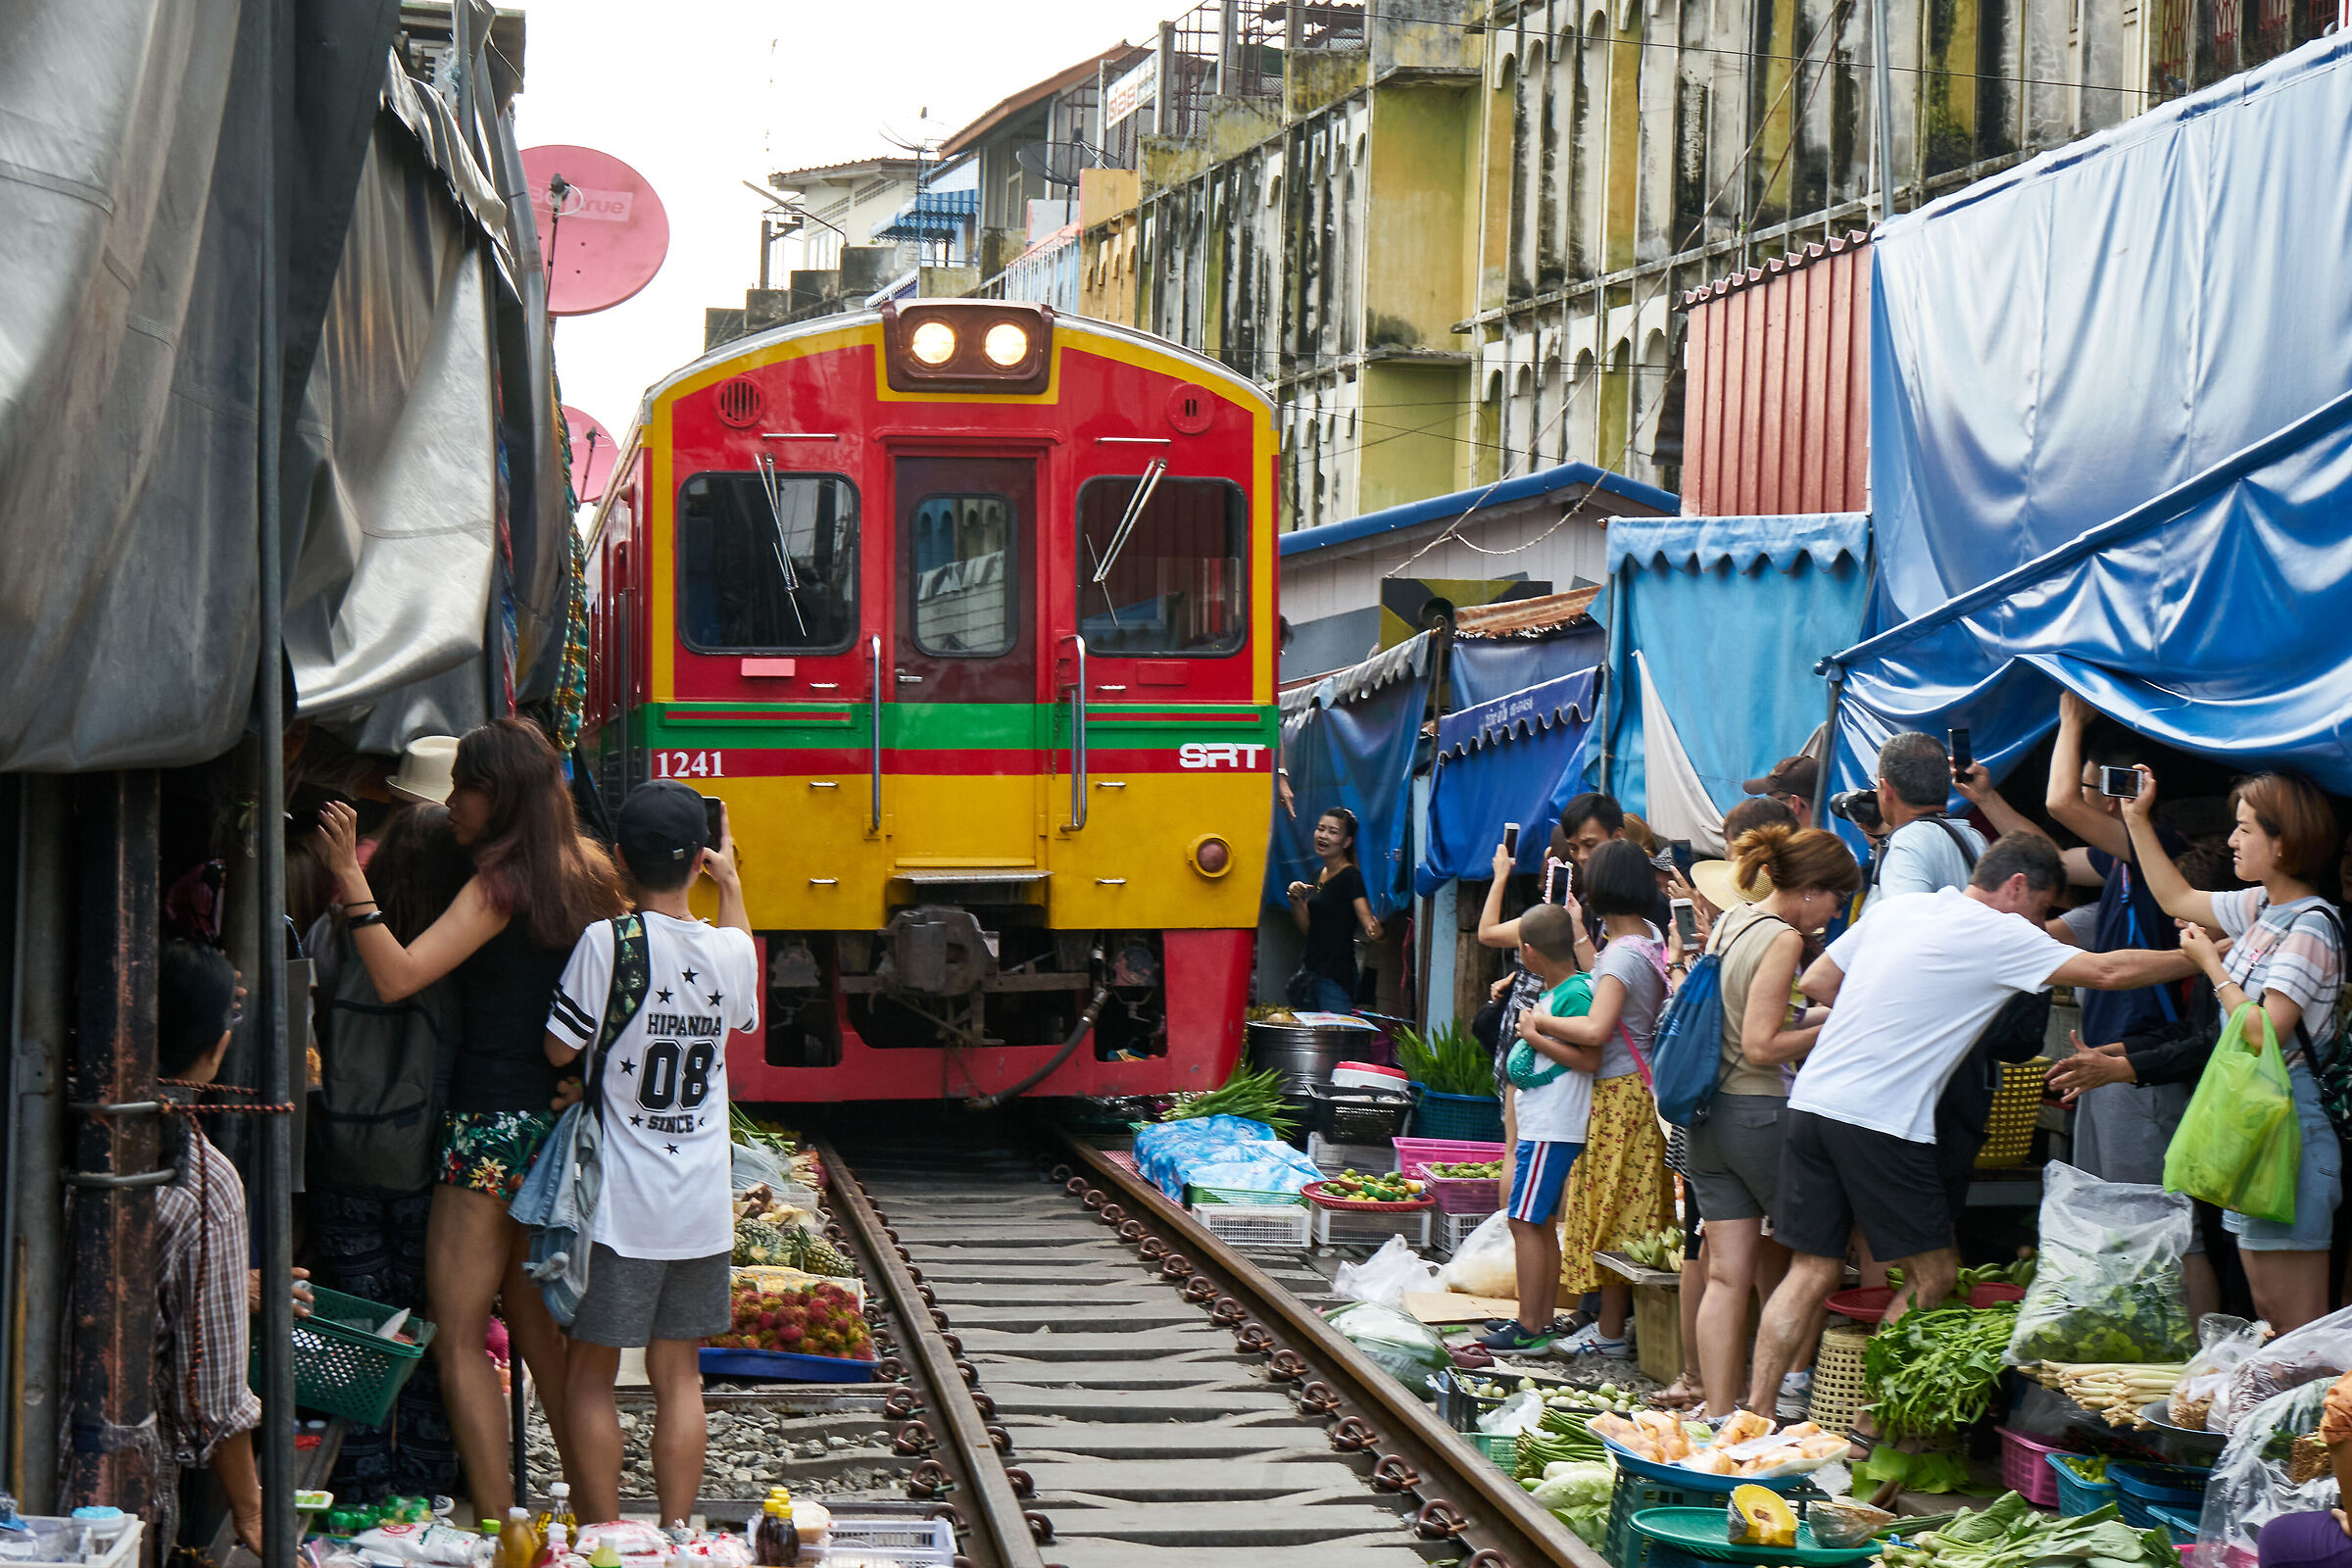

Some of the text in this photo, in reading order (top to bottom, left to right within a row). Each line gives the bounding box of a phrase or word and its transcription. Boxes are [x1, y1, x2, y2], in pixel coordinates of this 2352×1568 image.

[657, 751, 725, 778] 1241
[1179, 743, 1266, 769] SRT
[647, 1013, 722, 1037] HIPANDA
[636, 1039, 717, 1113] 08
[647, 1114, 695, 1134] SINCE
